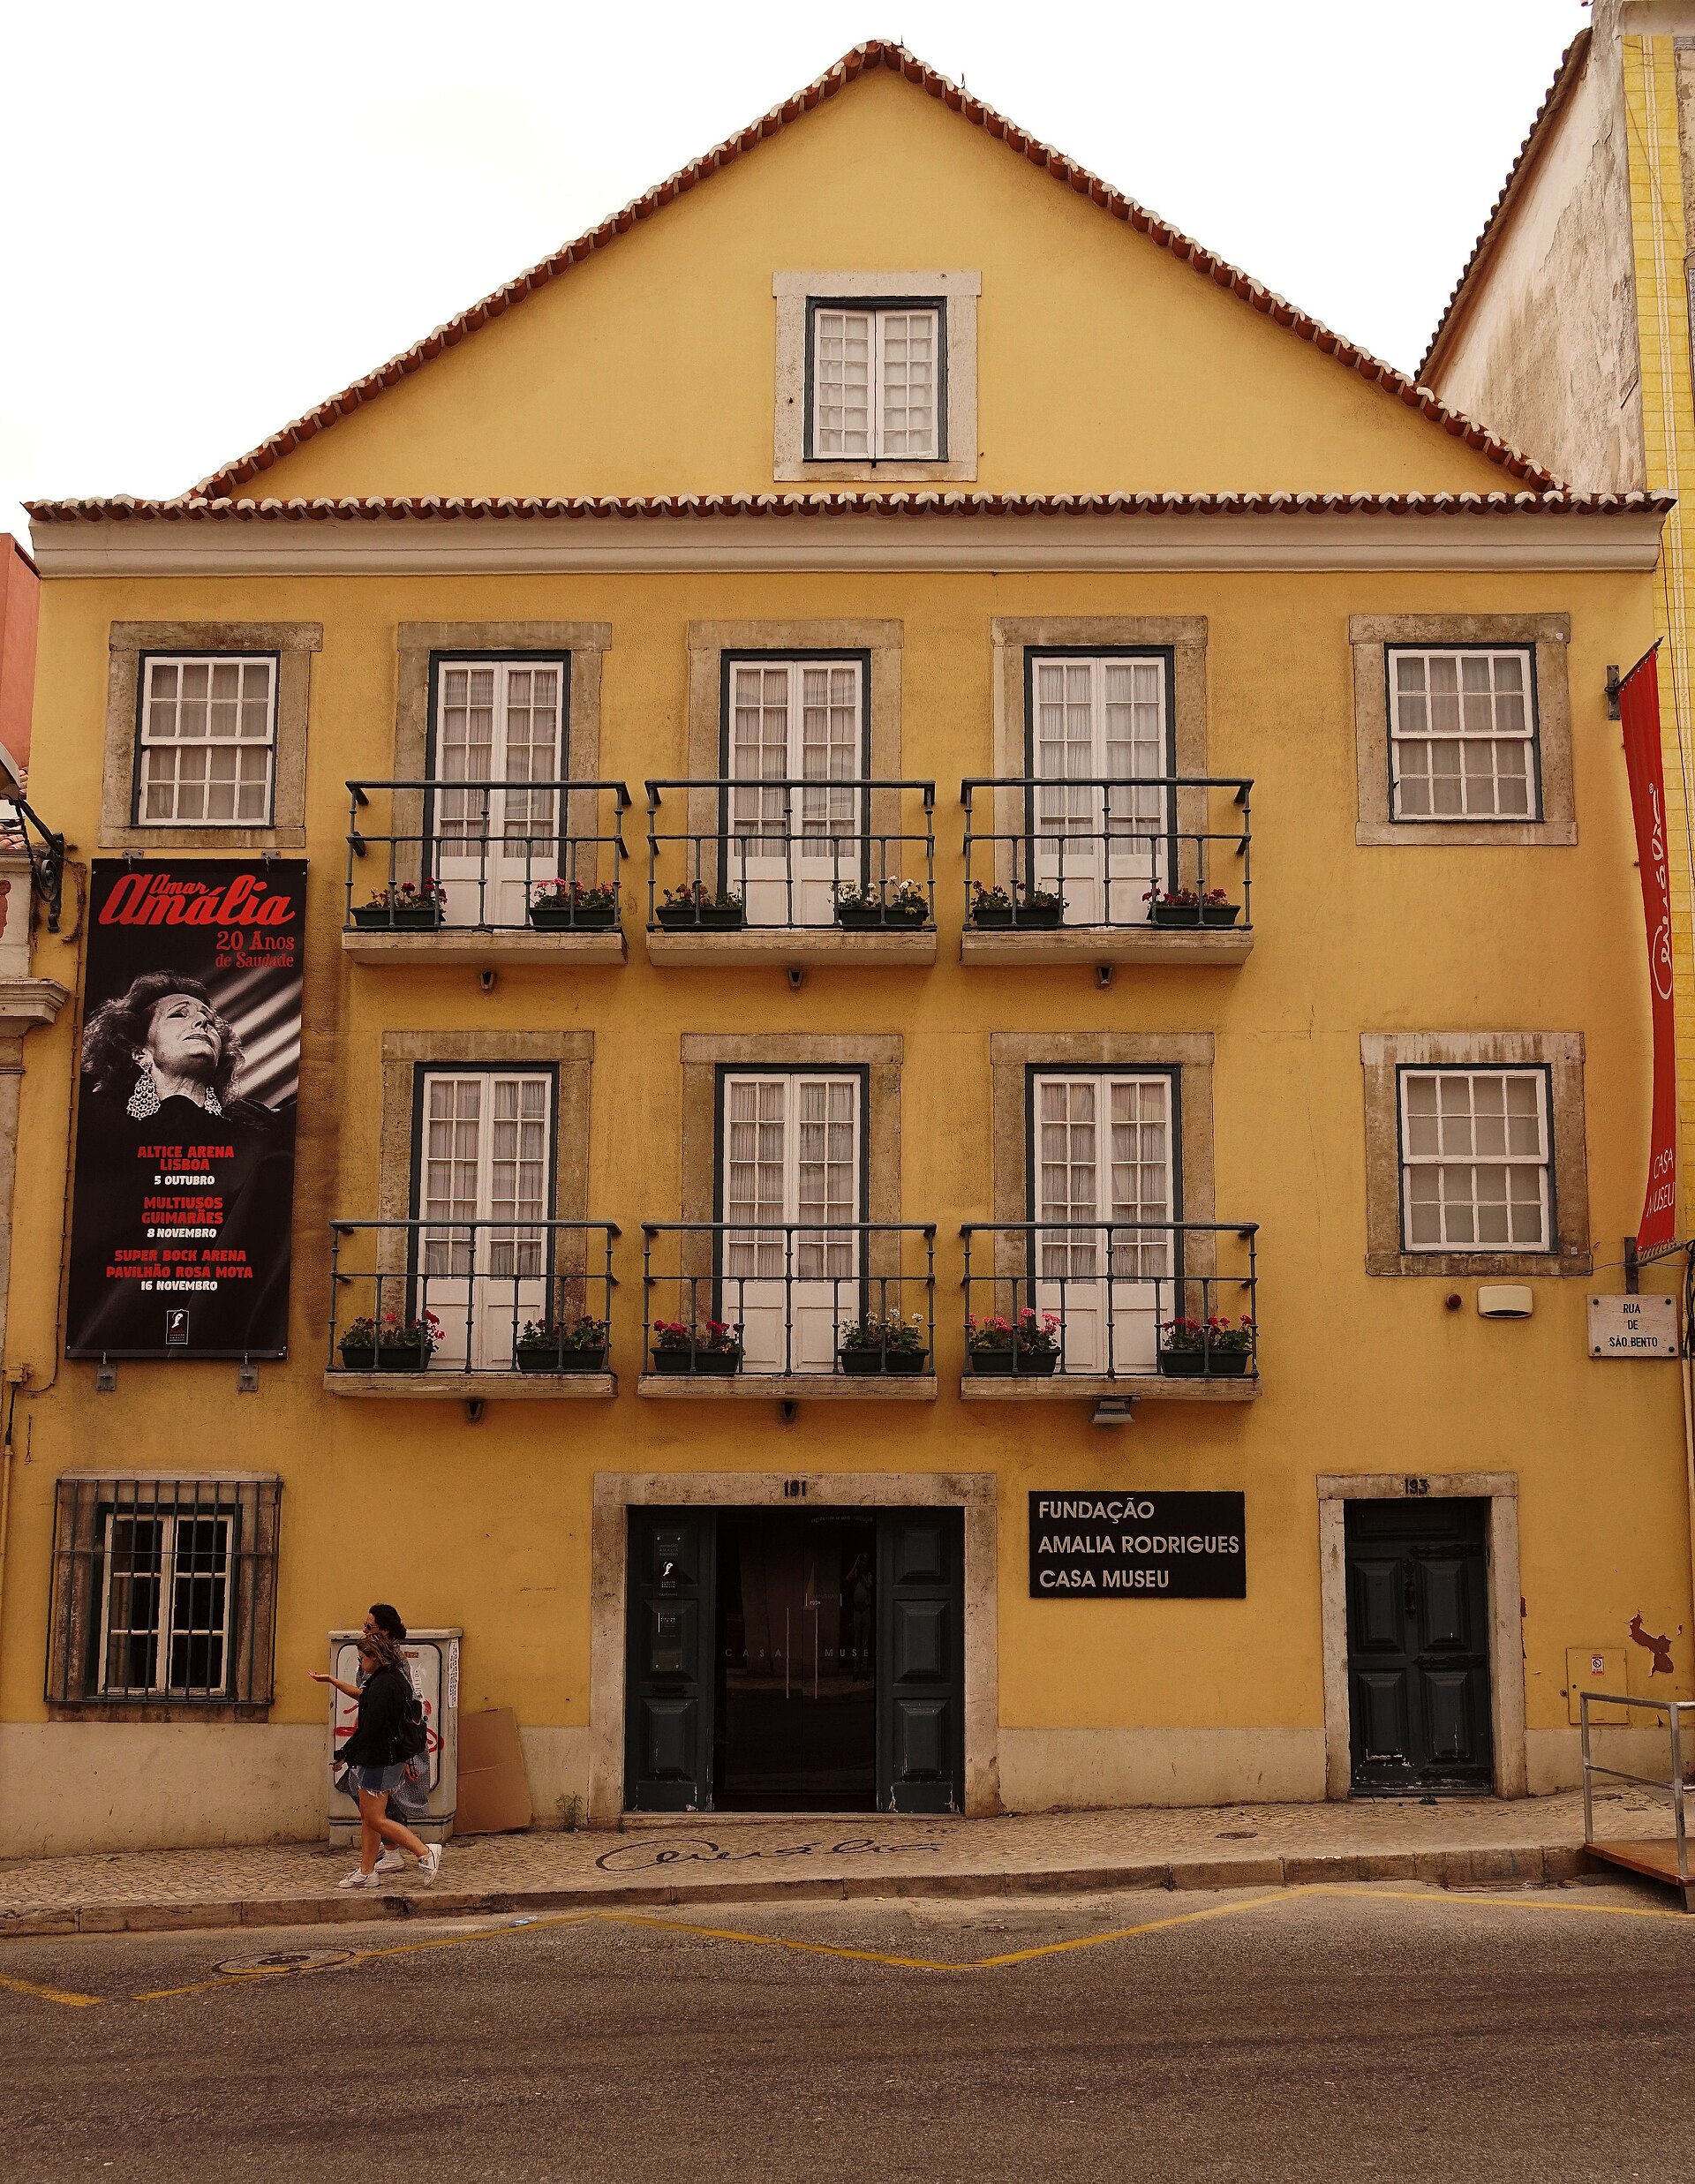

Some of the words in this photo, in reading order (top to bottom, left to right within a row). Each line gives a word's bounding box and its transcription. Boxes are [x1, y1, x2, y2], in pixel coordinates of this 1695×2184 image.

[150, 874, 209, 895] Amar
[98, 873, 296, 926] Amália
[216, 931, 244, 951] 20
[249, 930, 295, 951] Anos
[215, 952, 232, 968] de
[236, 951, 294, 968] Saudade
[137, 1146, 183, 1158] ALTICE
[187, 1145, 235, 1158] ARENA
[160, 1158, 210, 1171] LISBOA
[1654, 1147, 1674, 1179] CASA
[154, 1176, 162, 1186] 5
[164, 1175, 215, 1186] OUTUBRO
[144, 1196, 223, 1209] MULTIUSOS
[1646, 1181, 1676, 1217] MUSEU
[141, 1209, 223, 1224] GUIMARÃES
[147, 1228, 155, 1238] 8
[156, 1228, 217, 1239] NOVEMBRO
[114, 1250, 158, 1261] SUPER
[162, 1249, 197, 1261] BOCK
[201, 1249, 246, 1261] ARENA
[106, 1264, 170, 1278] PAVILHÃO
[176, 1266, 211, 1278] ROSA
[215, 1266, 253, 1278] MOTA
[140, 1281, 153, 1291] 16
[156, 1280, 218, 1291] NOVEMBRO
[1623, 1303, 1641, 1314] RUA
[1627, 1319, 1638, 1330] DE
[1608, 1335, 1629, 1348] SÃO
[1630, 1336, 1658, 1348] BENTO
[784, 1479, 807, 1497] 191
[1405, 1478, 1428, 1495] 193
[1038, 1497, 1155, 1525] FUNDAÇÃO
[1037, 1535, 1116, 1554] AMALIA
[1122, 1535, 1239, 1554] RODRIGUES
[1039, 1570, 1096, 1588] CASA
[1102, 1570, 1170, 1588] MUSEU
[725, 1648, 782, 1658] CASA
[825, 1648, 869, 1658] MUSE
